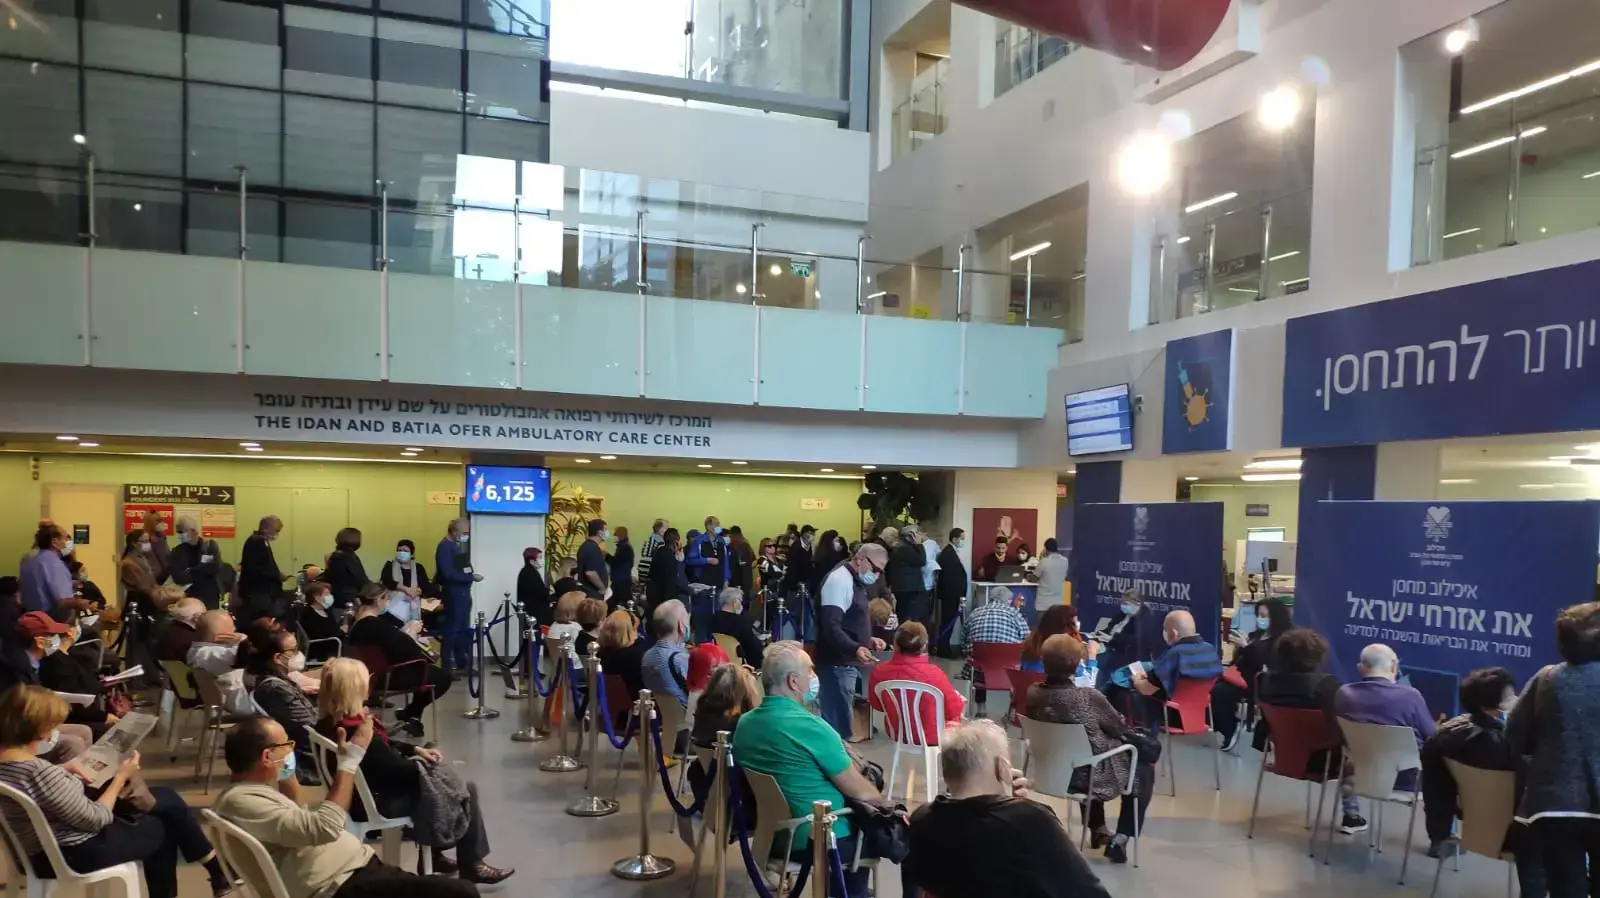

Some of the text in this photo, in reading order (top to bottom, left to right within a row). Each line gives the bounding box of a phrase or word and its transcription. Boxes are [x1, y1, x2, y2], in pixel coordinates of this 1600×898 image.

[1315, 319, 1596, 411] יותר להתחסן.
[253, 393, 712, 428] המרכז לשירותי רפואה אמבולטורים על שם עידן ובתיה עופר
[254, 415, 712, 448] THE IDAN AND BATIA OFER AMBULATORY CARE CENTER
[130, 485, 211, 497] בניין ראשונים
[486, 484, 535, 503] 6,125
[1095, 570, 1131, 594] ישראל
[1170, 582, 1191, 600] את
[1392, 579, 1478, 599] איכילוב מחסן
[1347, 591, 1533, 638] את אזרחי ישראל
[1344, 623, 1380, 638] למדינה
[1422, 632, 1468, 650] הבריאות
[1471, 639, 1489, 653] את
[1491, 641, 1532, 658] ומחזיר
